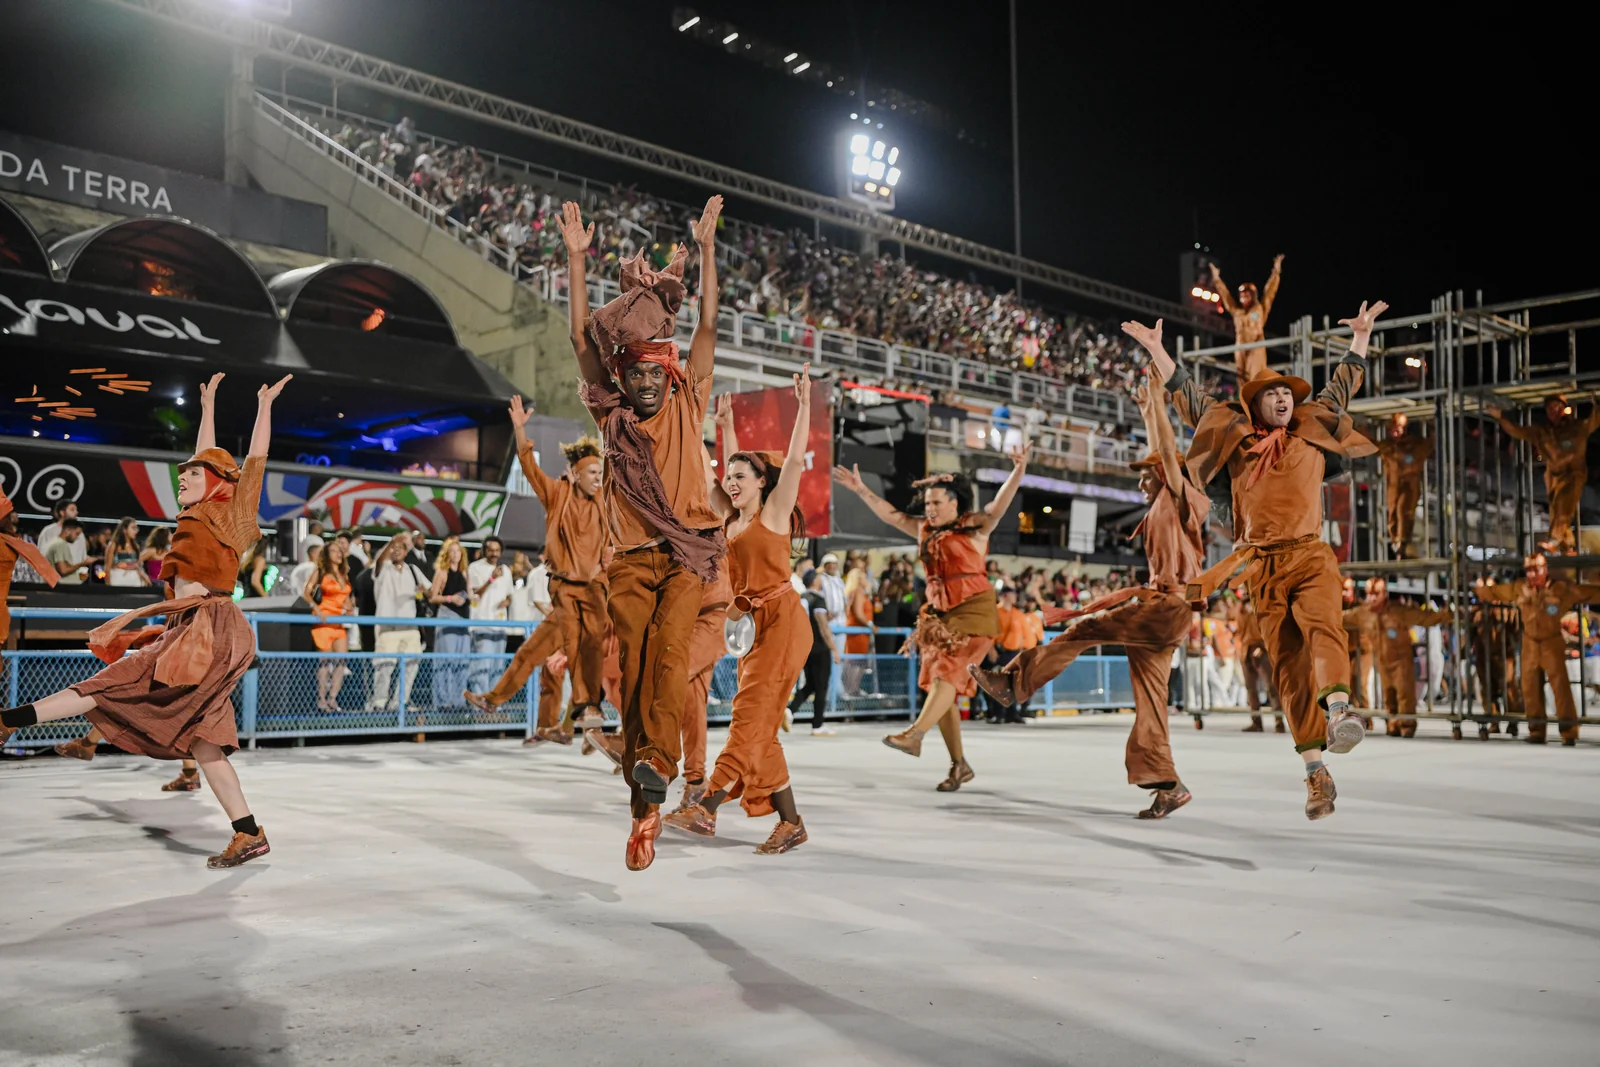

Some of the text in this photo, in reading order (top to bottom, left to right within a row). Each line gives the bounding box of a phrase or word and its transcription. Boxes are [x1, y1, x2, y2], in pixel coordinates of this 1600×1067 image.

[0, 150, 173, 212] DA TERRA
[45, 477, 67, 500] 6
